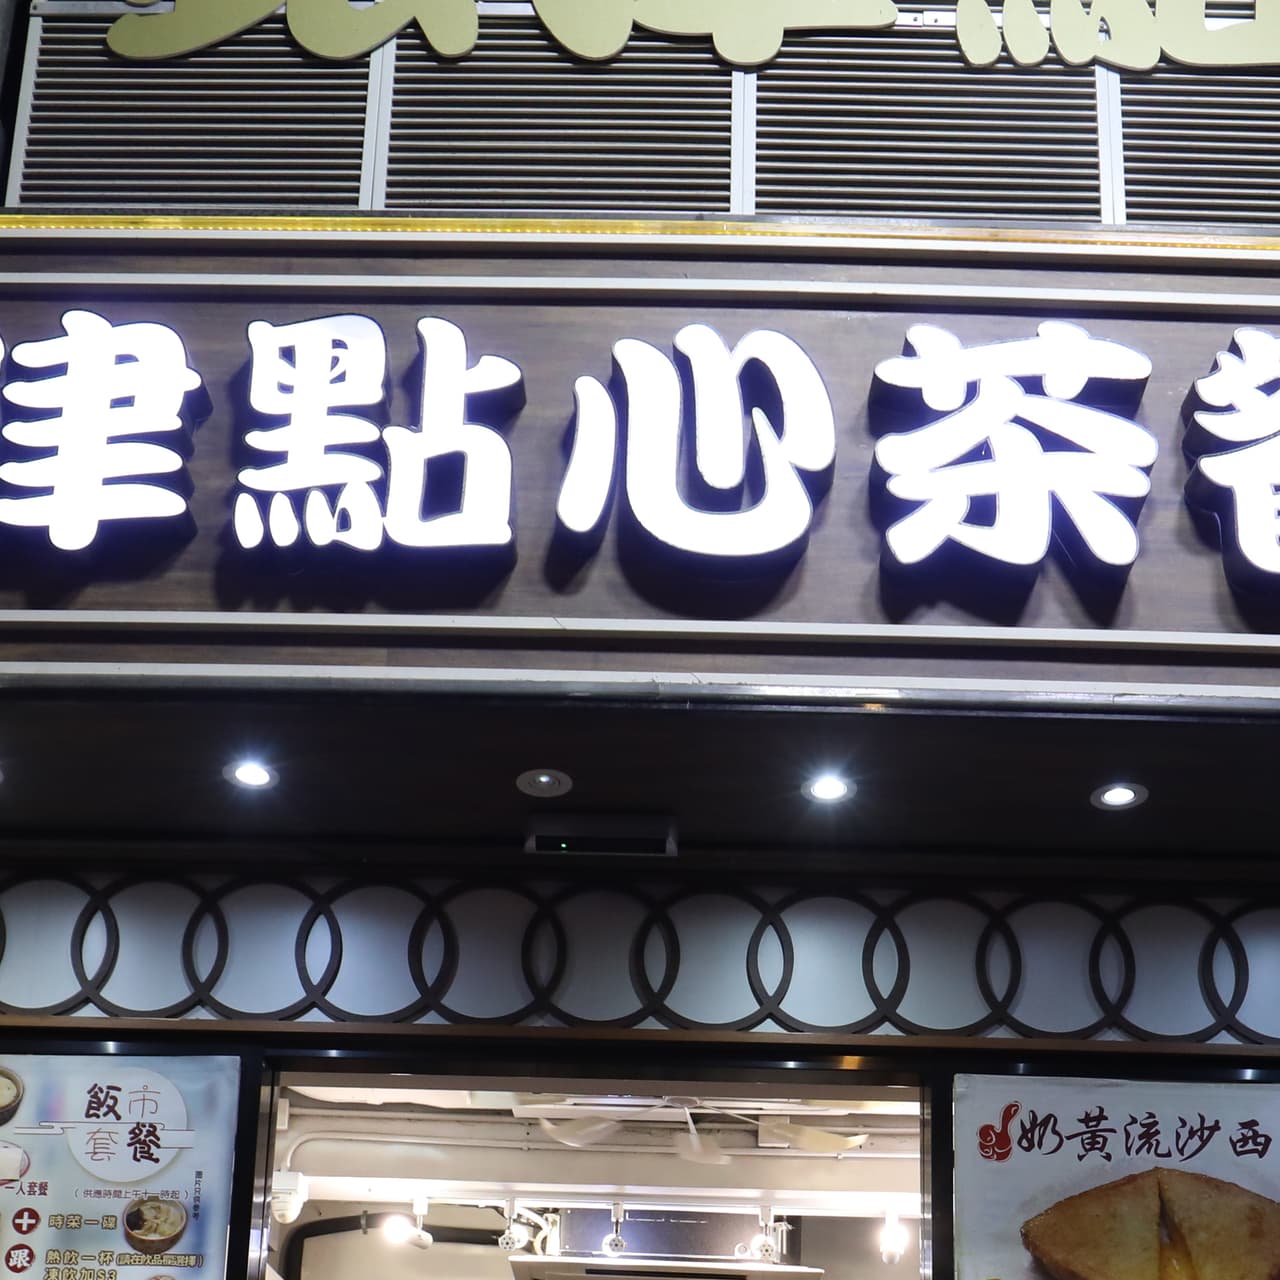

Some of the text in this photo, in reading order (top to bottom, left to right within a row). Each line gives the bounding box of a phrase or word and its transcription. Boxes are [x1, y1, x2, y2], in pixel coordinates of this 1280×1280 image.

[84, 1082, 162, 1122] 飯市
[84, 1121, 162, 1165] 套餐
[4, 1181, 49, 1197] 一人套餐
[48, 1214, 118, 1230] 時菜一碟
[8, 1249, 32, 1269] 跟
